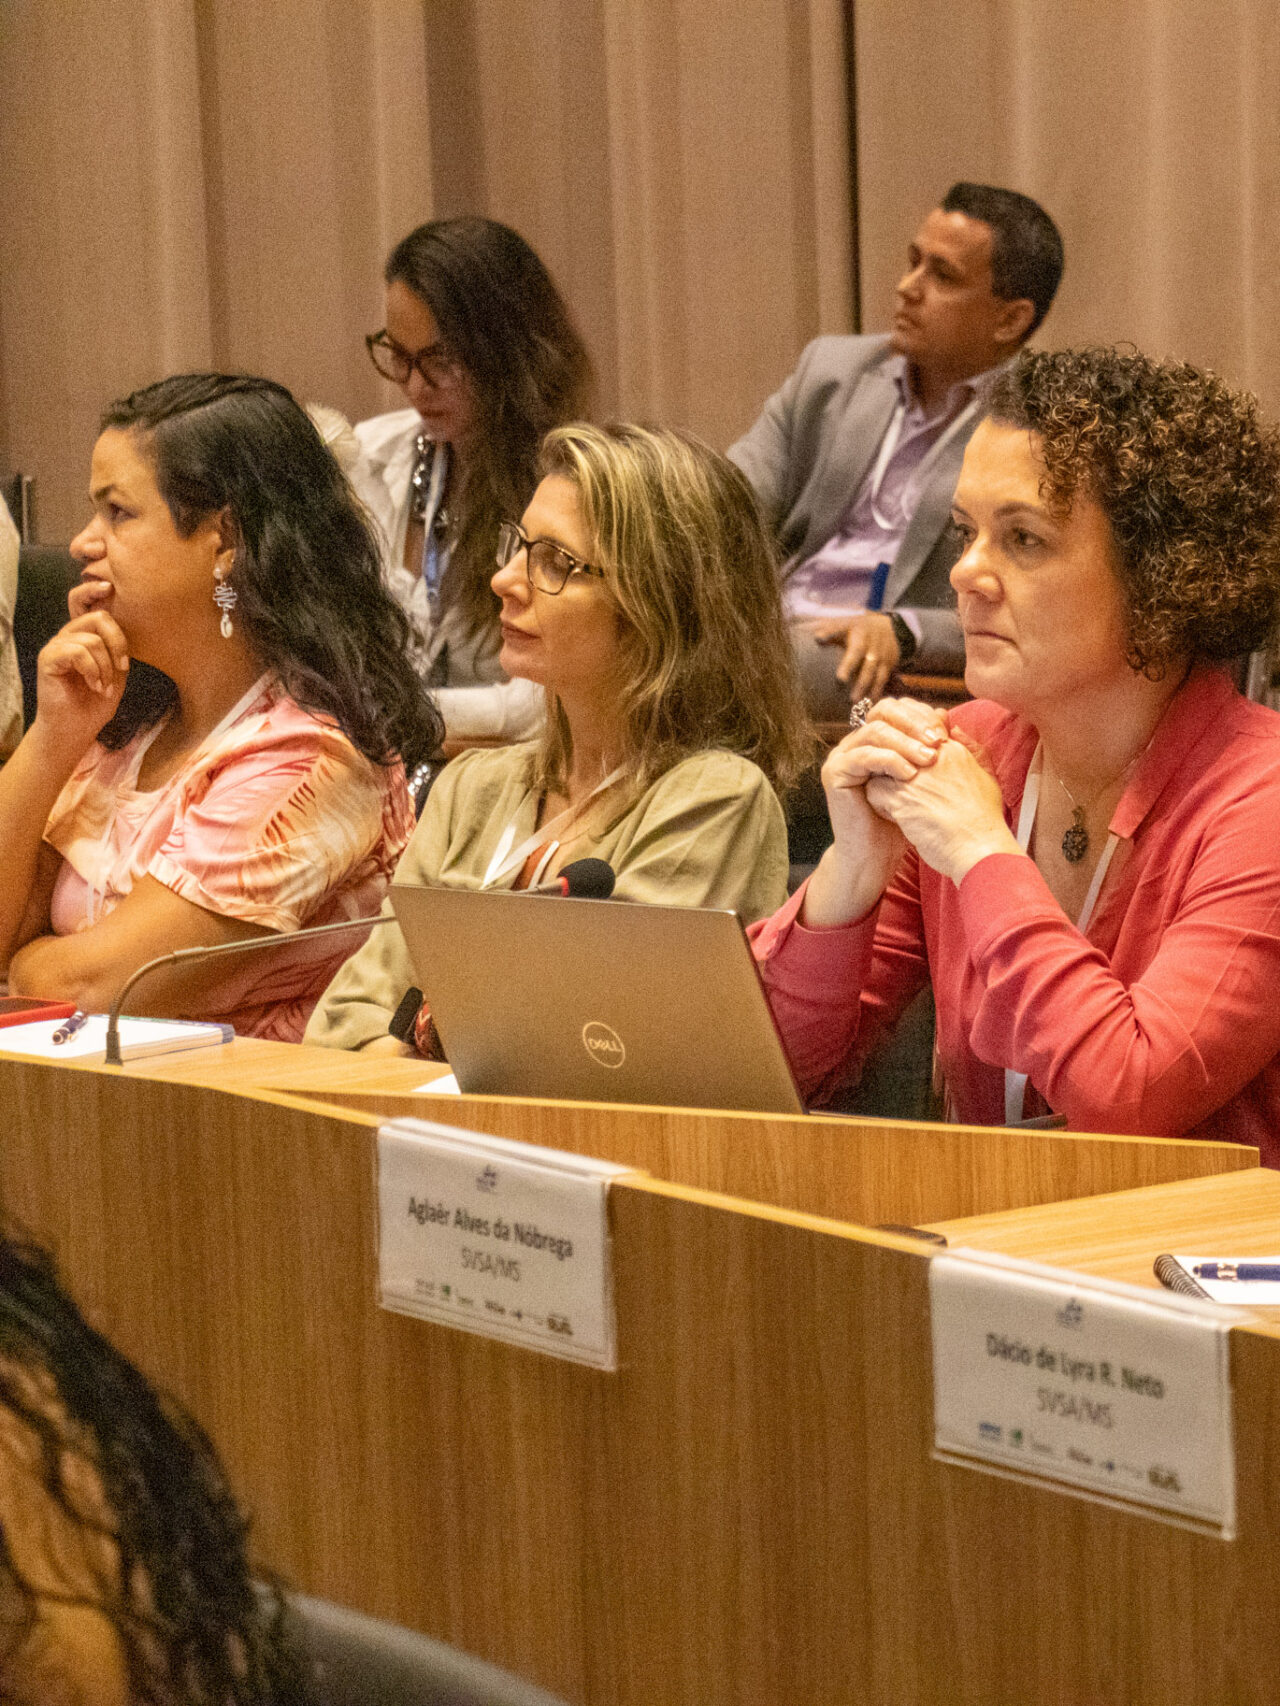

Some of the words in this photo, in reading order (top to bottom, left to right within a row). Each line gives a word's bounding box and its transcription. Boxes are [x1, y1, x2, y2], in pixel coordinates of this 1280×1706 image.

[588, 1037, 622, 1052] DELL
[453, 1207, 490, 1237] Alves
[493, 1217, 510, 1242] da
[1036, 1346, 1056, 1373] de
[1061, 1351, 1096, 1384] Lyra
[1121, 1366, 1165, 1400] Neto
